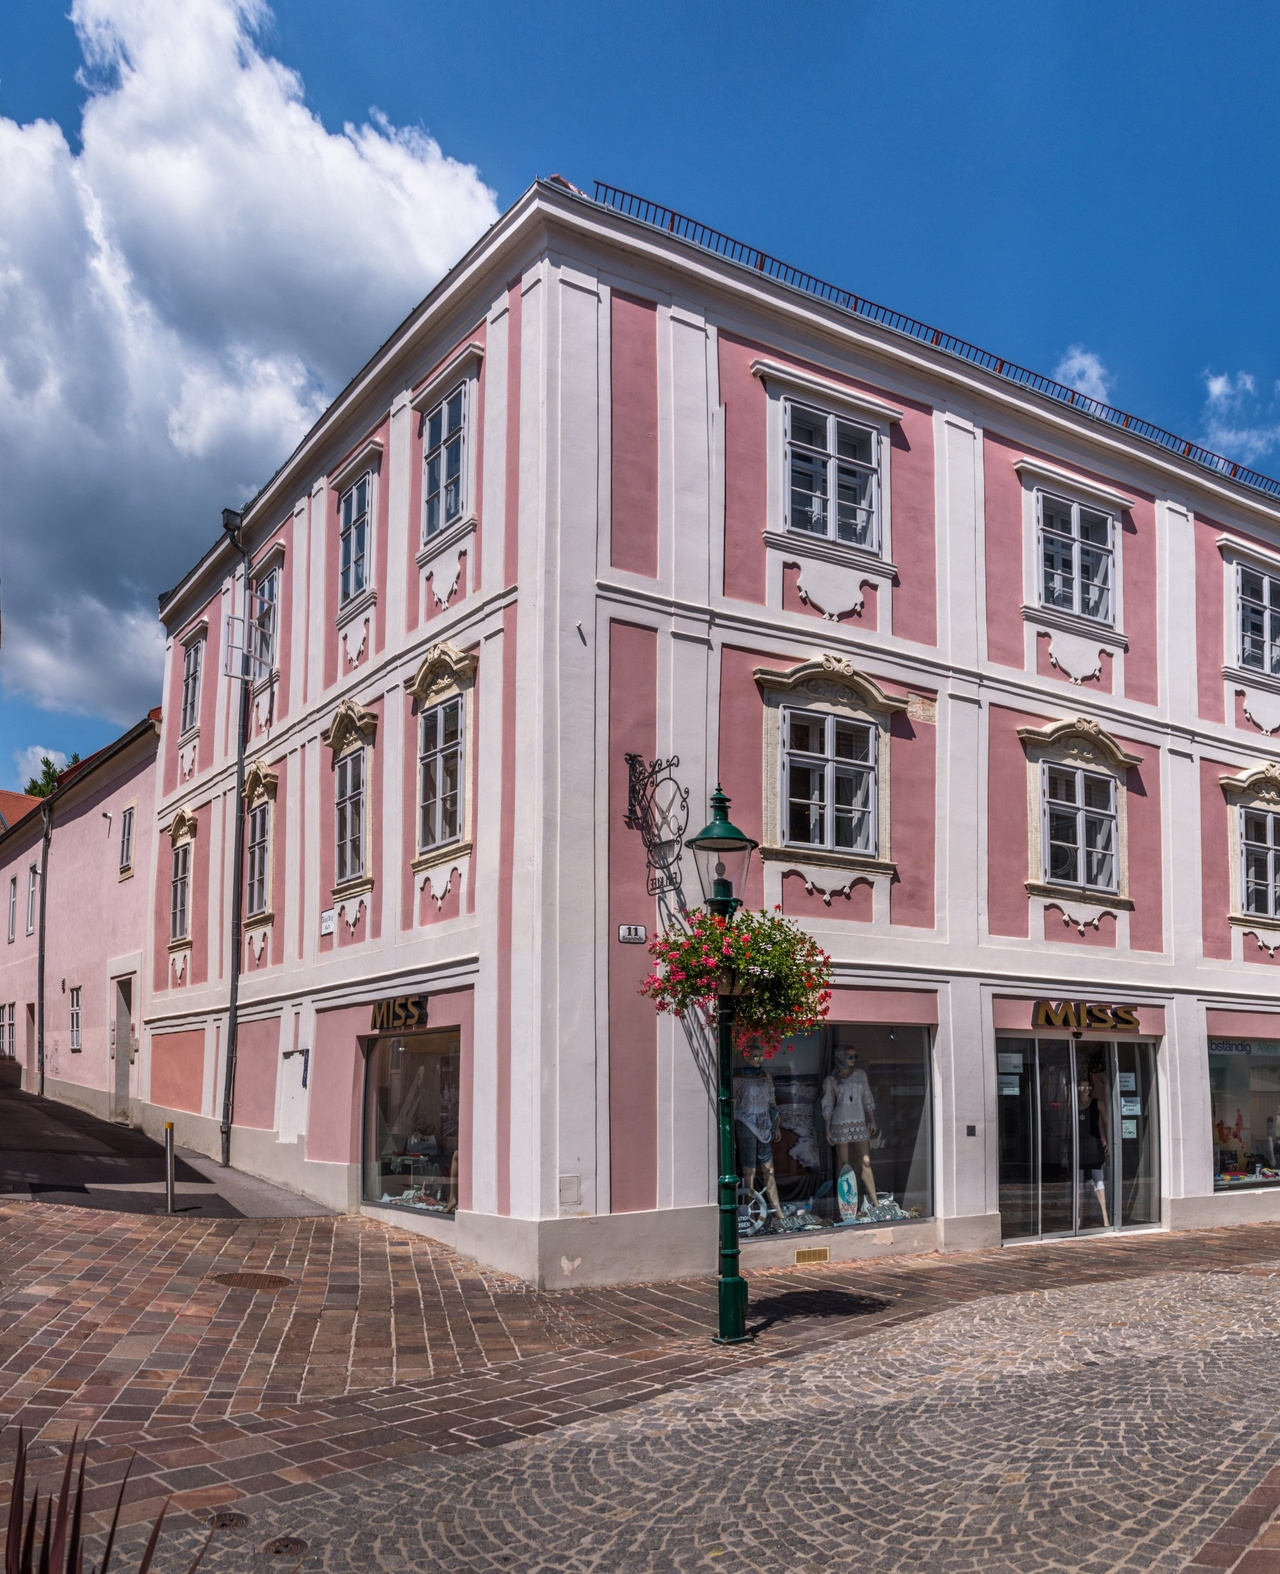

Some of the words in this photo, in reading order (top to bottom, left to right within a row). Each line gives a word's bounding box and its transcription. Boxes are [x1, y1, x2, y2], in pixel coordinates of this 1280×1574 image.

[626, 926, 639, 937] 11
[371, 996, 420, 1030] MISS
[1036, 1000, 1141, 1030] MISS
[1210, 1040, 1251, 1055] bständig
